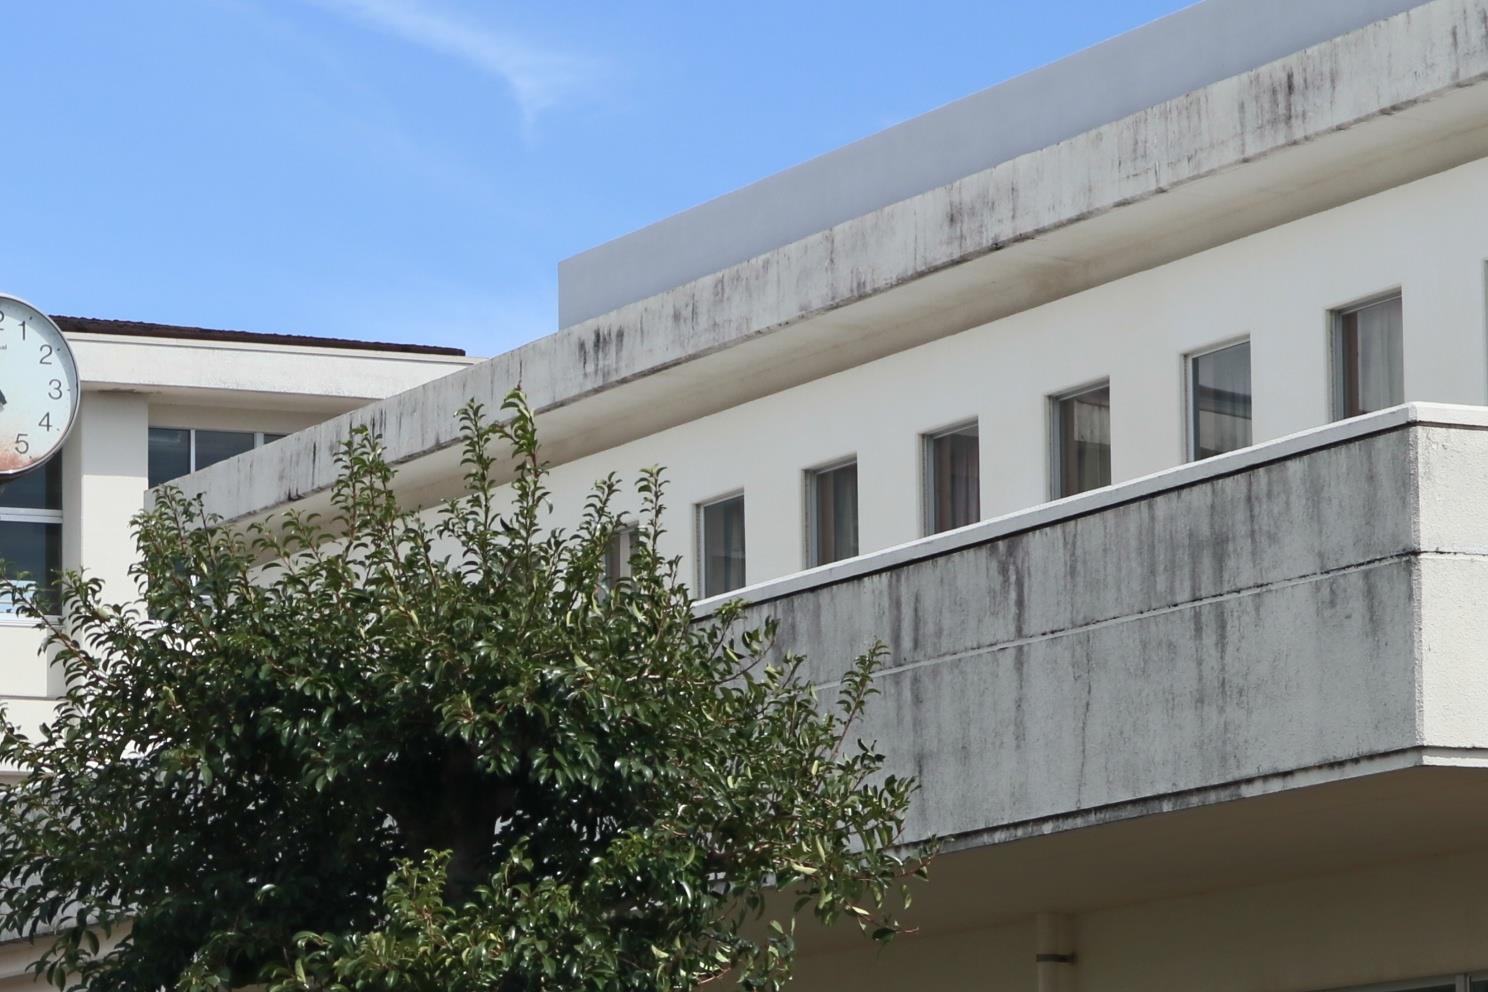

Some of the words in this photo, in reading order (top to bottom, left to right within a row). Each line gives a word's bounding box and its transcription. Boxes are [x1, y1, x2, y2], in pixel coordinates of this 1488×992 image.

[18, 320, 26, 341] 1
[39, 344, 52, 365] 2
[48, 379, 63, 400] 3
[38, 412, 52, 432] 4
[14, 433, 29, 454] 5
